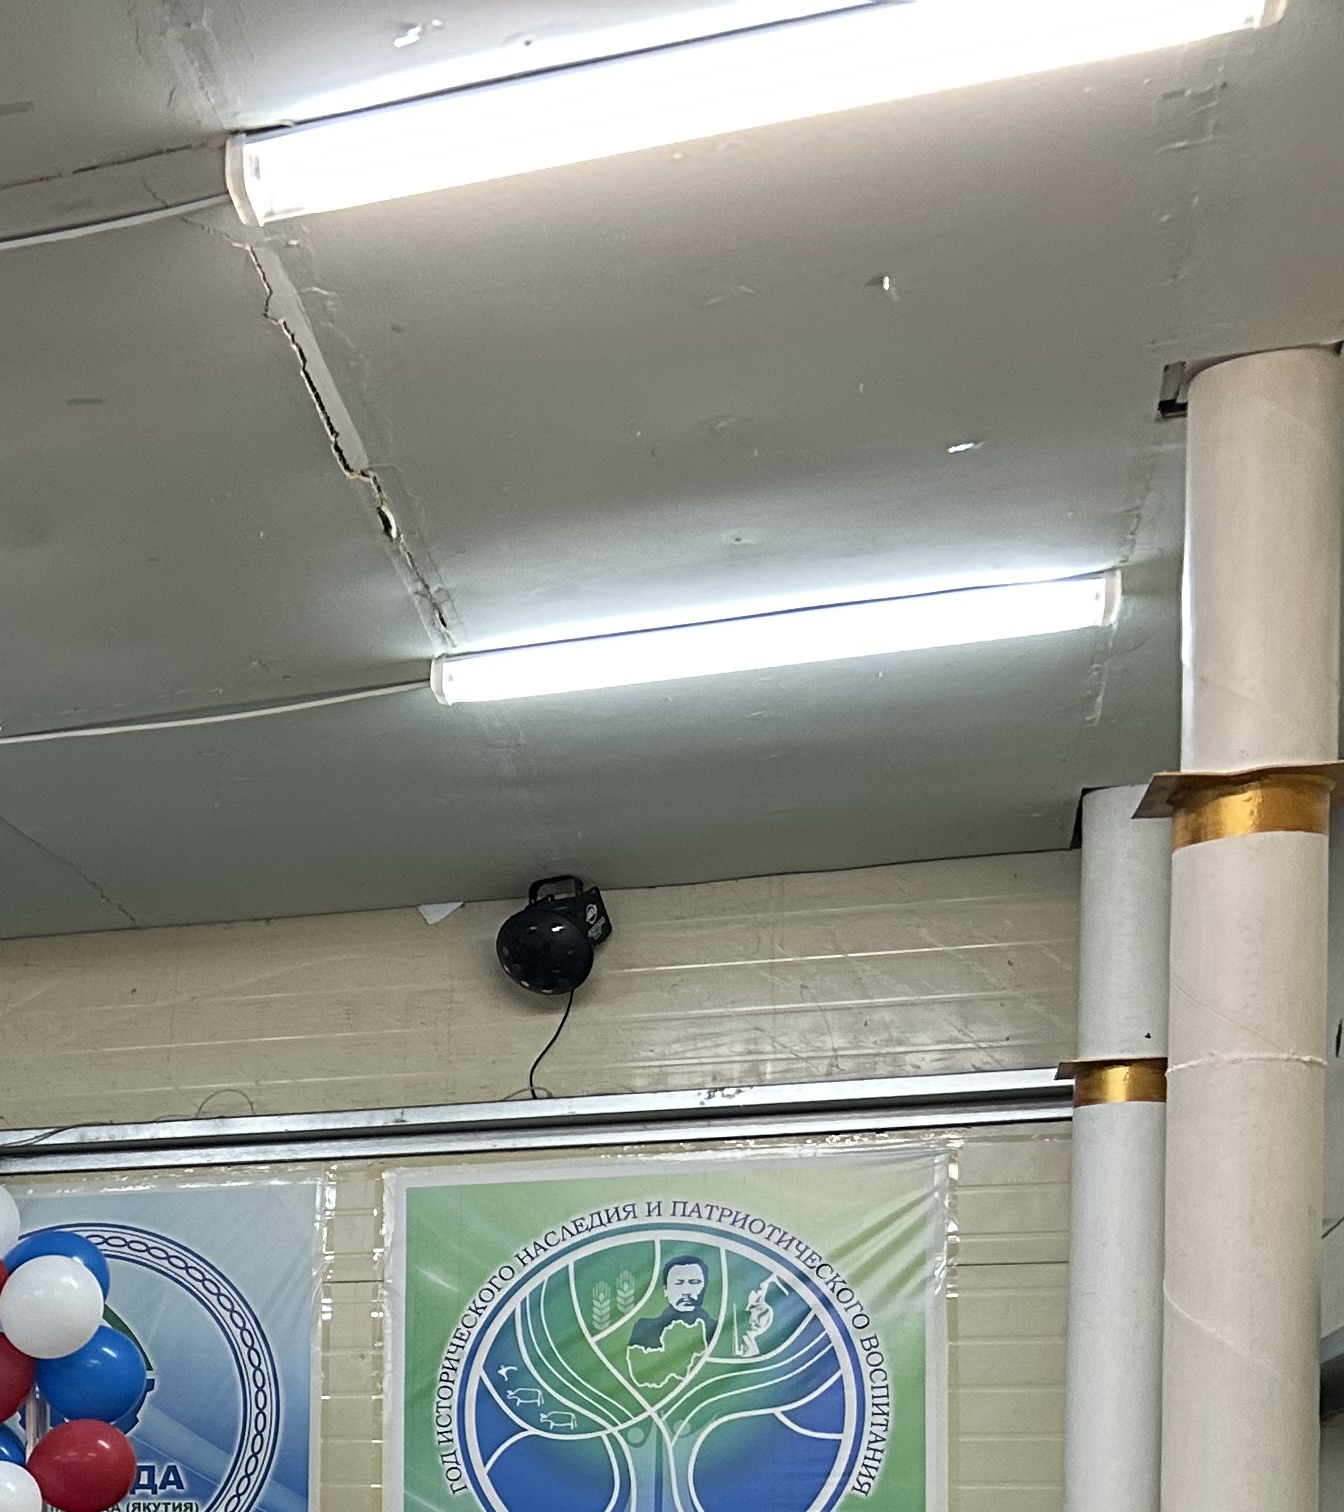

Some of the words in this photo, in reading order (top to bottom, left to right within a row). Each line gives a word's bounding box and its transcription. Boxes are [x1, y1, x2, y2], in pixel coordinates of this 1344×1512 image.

[514, 1200, 637, 1267] НАСЛЕДИЯ
[645, 1201, 662, 1217] И
[670, 1200, 870, 1331] ПАТРИОТИЧЕСКОГО
[435, 1265, 515, 1446] ИСТОРИЧЕСКОГО
[852, 1333, 890, 1496] ВОСПИТАНИЯ
[441, 1449, 468, 1495] ГОД
